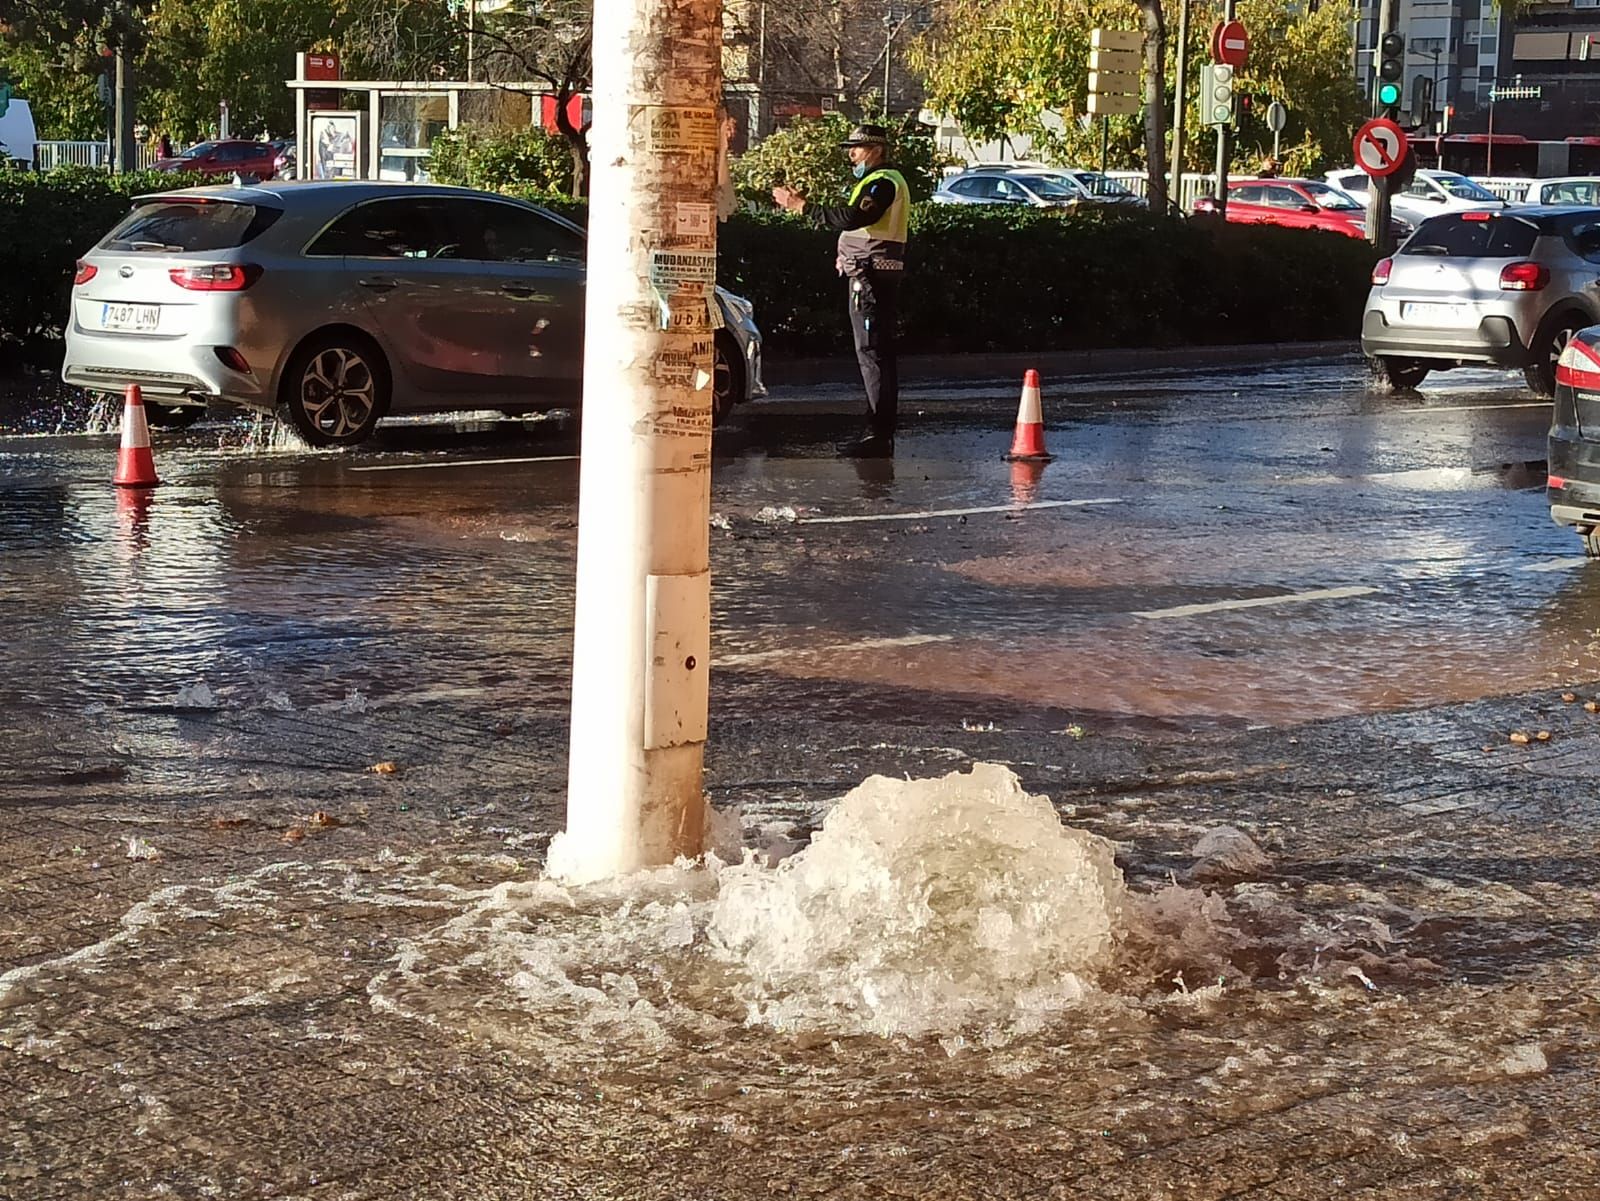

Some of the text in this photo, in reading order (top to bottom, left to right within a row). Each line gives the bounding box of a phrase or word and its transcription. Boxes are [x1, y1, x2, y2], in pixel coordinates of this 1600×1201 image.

[655, 254, 703, 267] MUDANZAS
[109, 306, 157, 324] 7487 LHN
